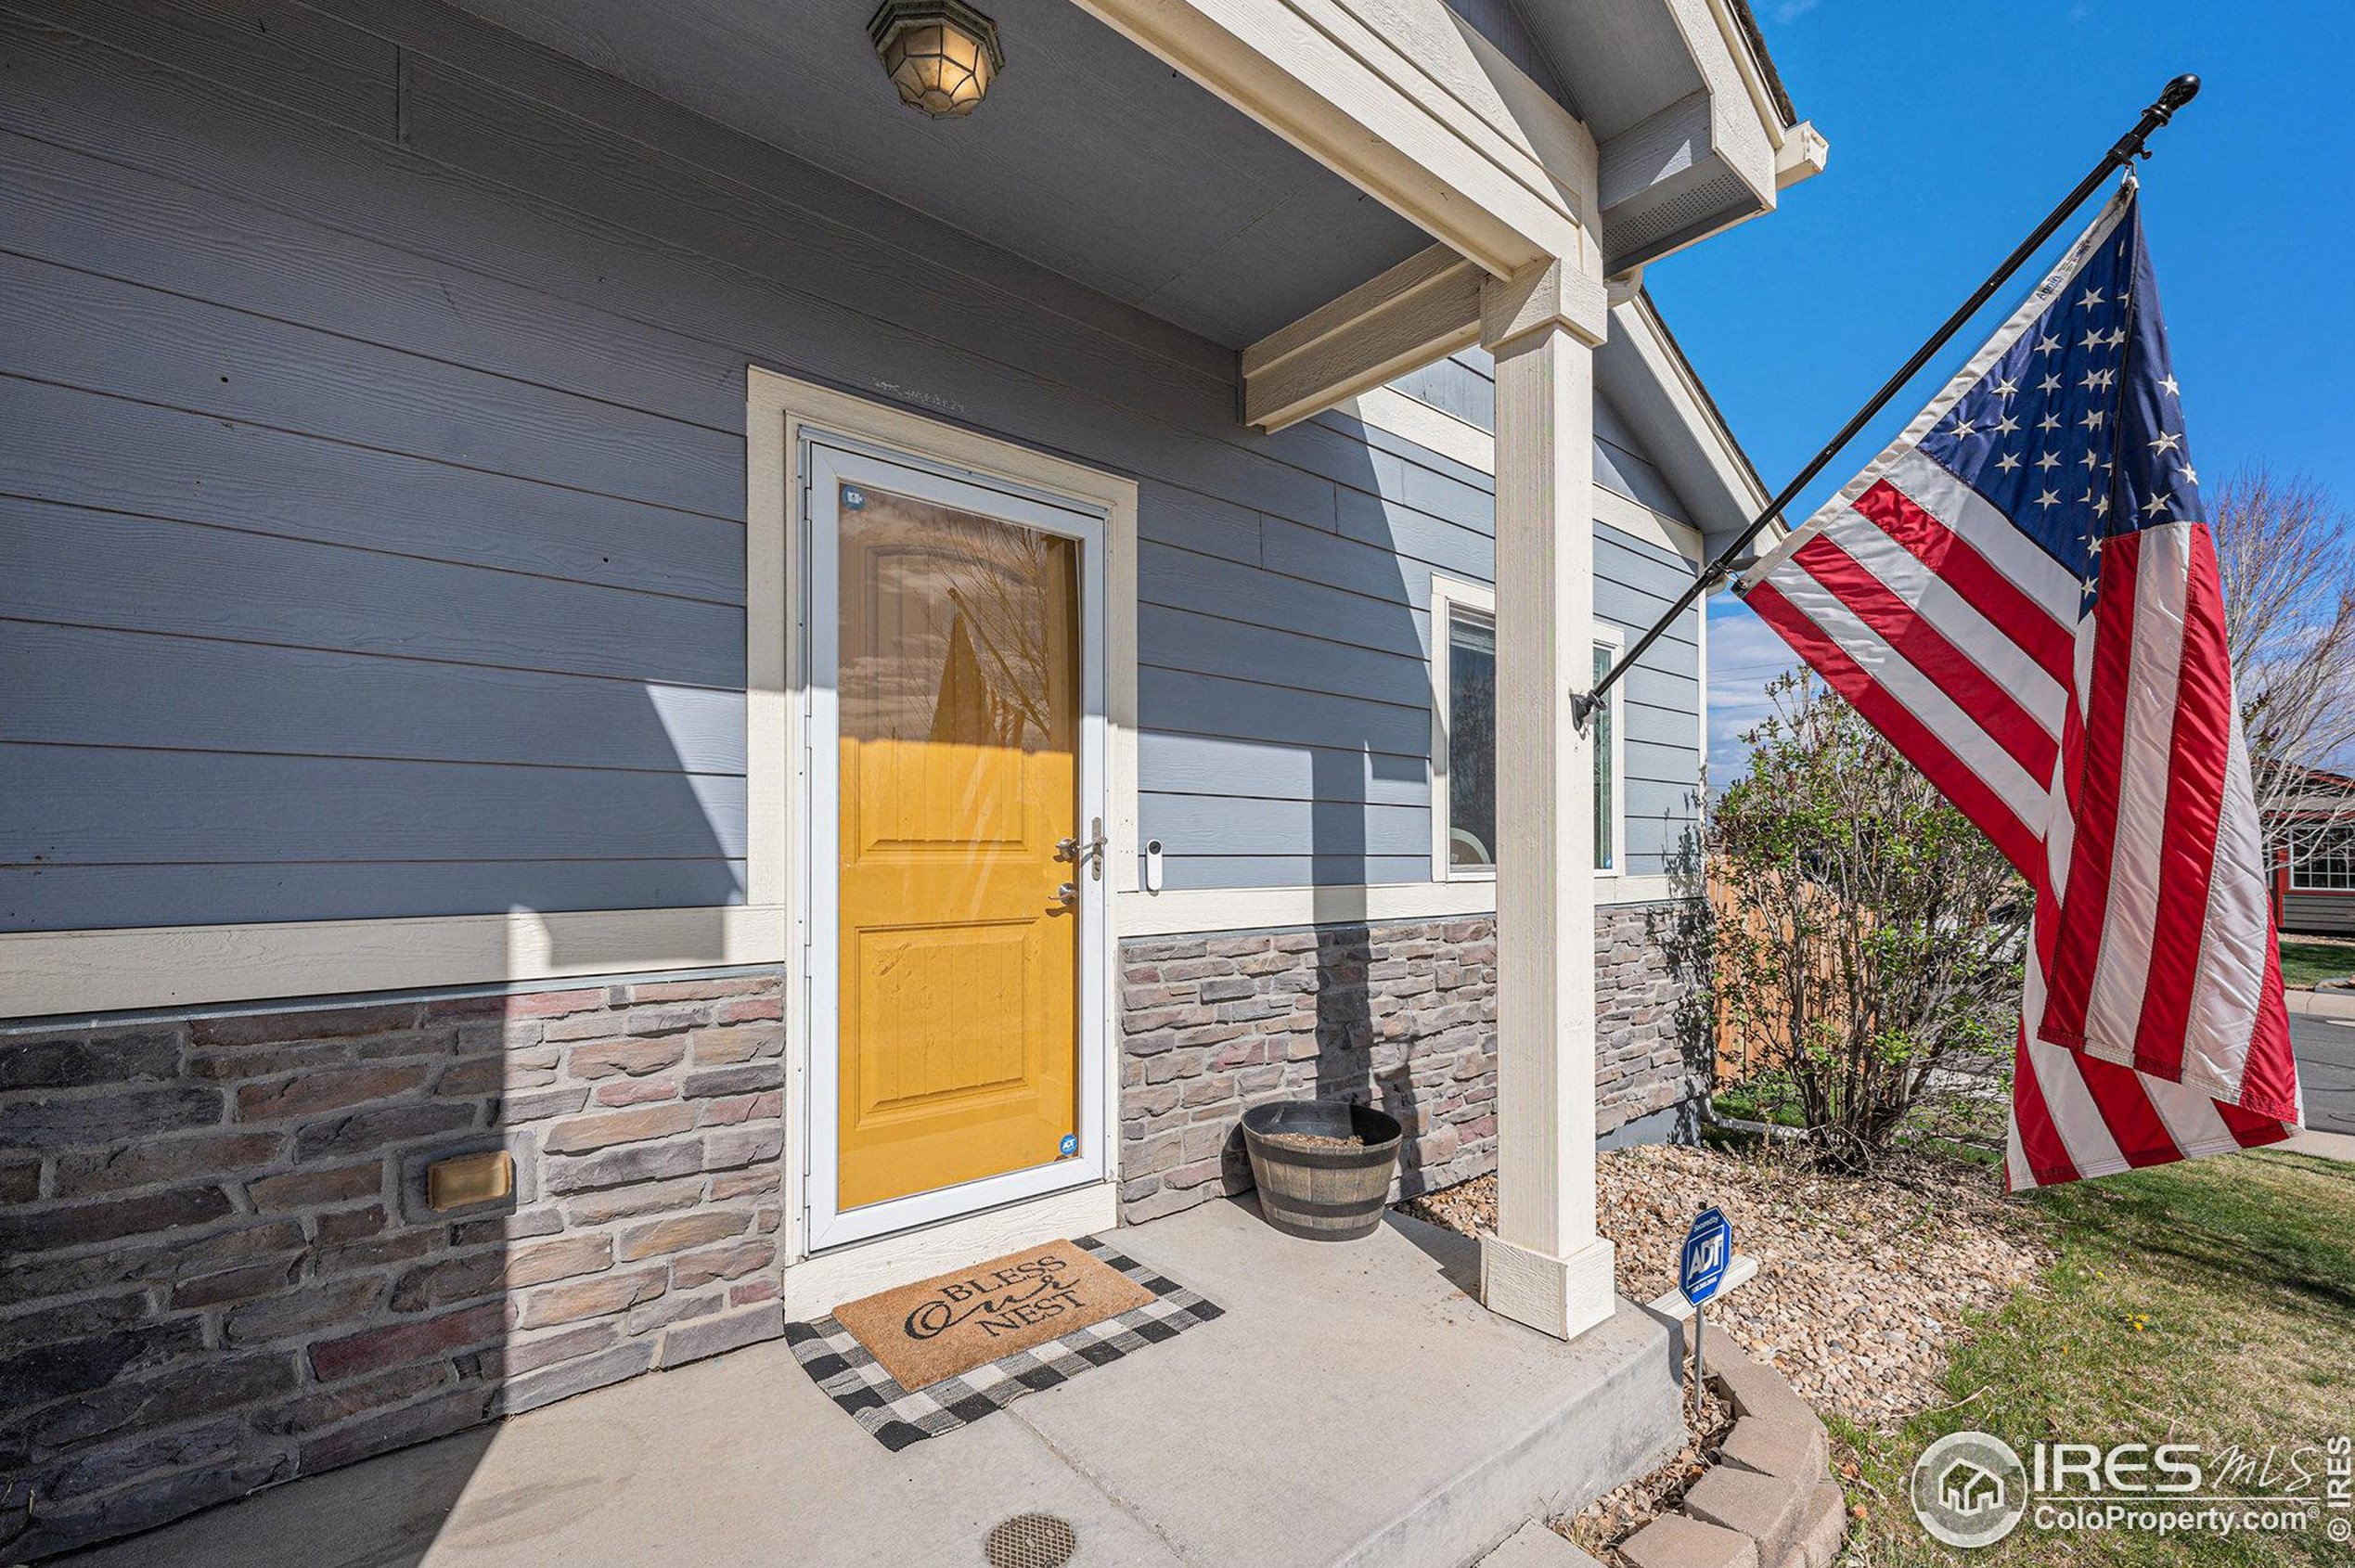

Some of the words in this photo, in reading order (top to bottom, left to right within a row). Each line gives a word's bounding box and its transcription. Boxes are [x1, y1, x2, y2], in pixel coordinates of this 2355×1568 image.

[937, 1255, 1067, 1303] BLESS
[1688, 1233, 1724, 1280] ADT
[904, 1275, 1081, 1341] Our
[974, 1290, 1086, 1337] NEST
